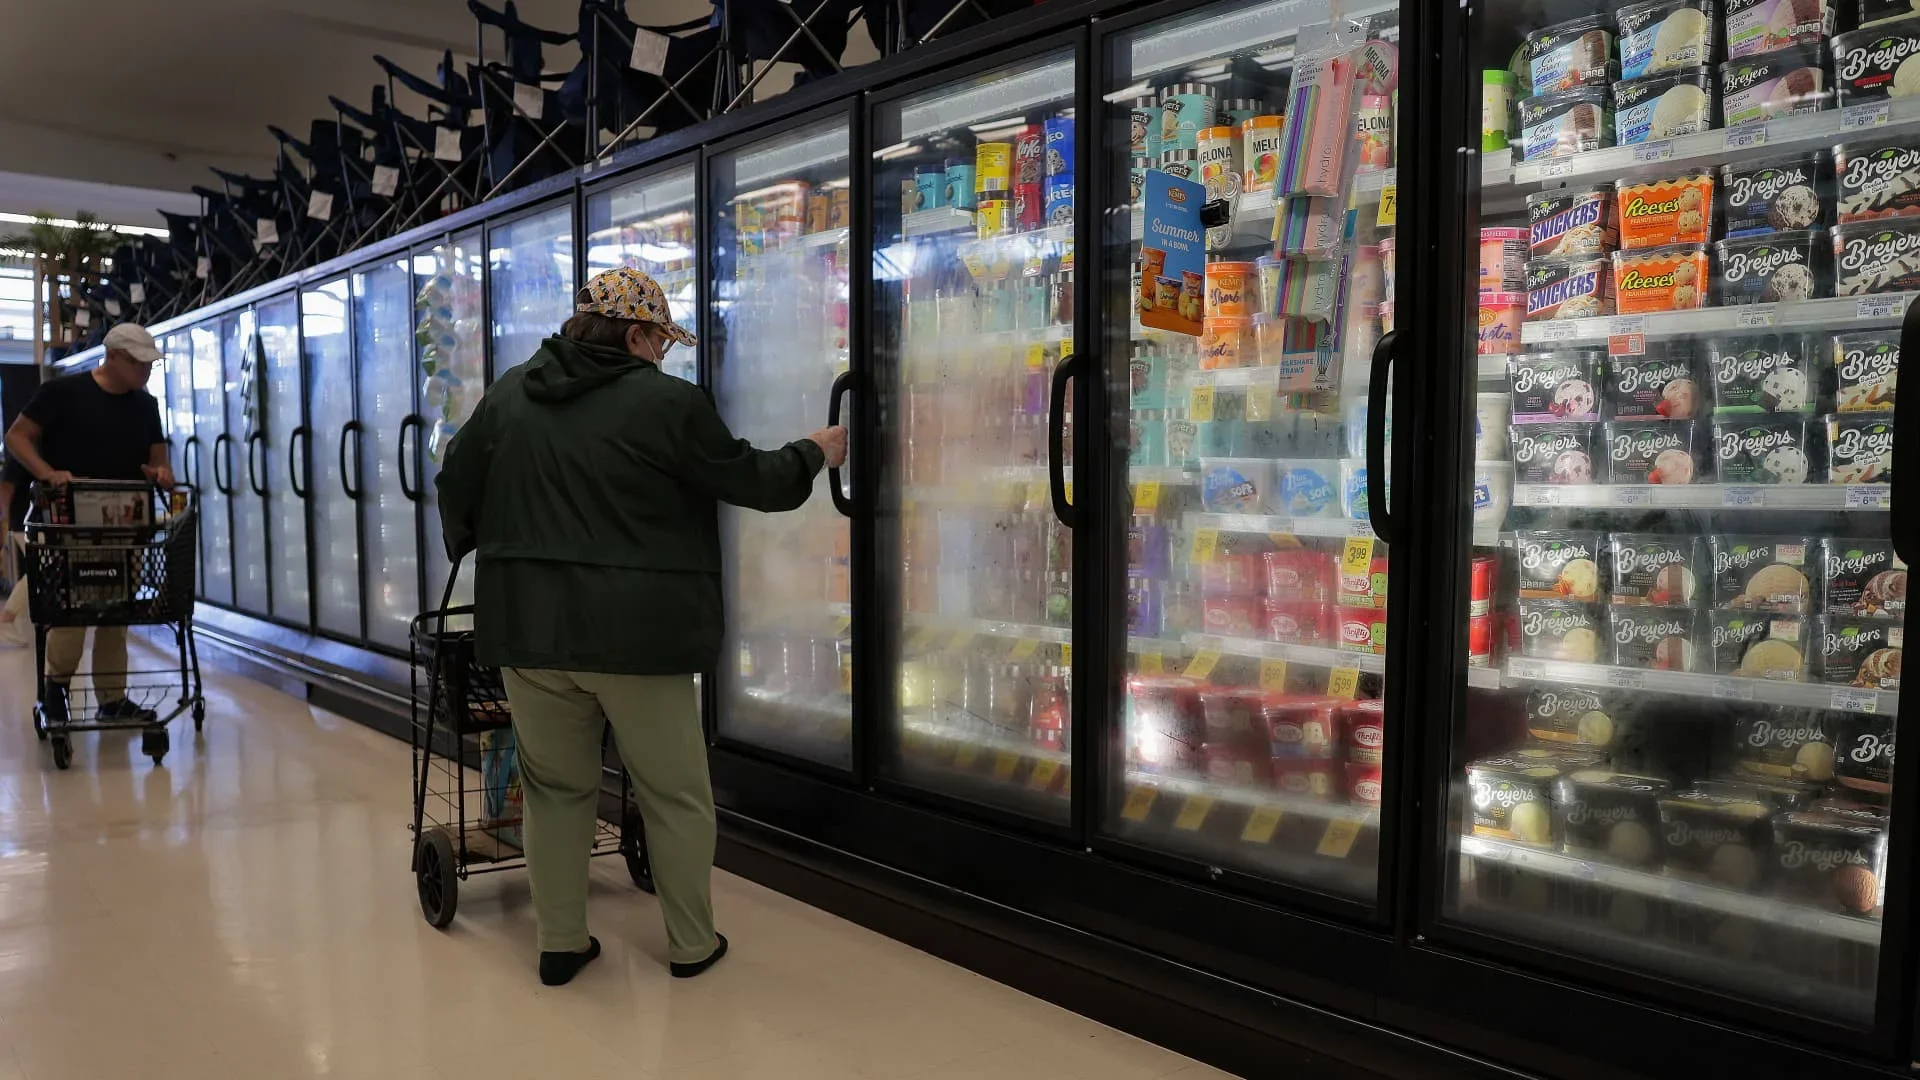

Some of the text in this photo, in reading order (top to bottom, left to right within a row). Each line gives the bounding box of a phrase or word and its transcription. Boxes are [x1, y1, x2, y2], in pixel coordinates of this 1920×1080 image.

[1531, 36, 1560, 57] Breyers
[1841, 37, 1920, 80] Breyer
[1364, 46, 1390, 80] MELONA
[1723, 65, 1769, 94] Breyers
[1616, 87, 1648, 109] Breyers
[1357, 116, 1391, 131] ELONA
[1047, 131, 1065, 144] EO
[1843, 149, 1920, 188] Breyer
[1729, 168, 1808, 207] Breyers
[1531, 201, 1560, 223] Breyers
[1624, 196, 1680, 218] Reese's
[1151, 217, 1201, 243] Summer
[1532, 200, 1600, 246] SNICKERS
[1725, 247, 1804, 282] Breyers
[1841, 233, 1920, 270] Breyer
[1527, 269, 1556, 291] Breyers
[1528, 272, 1597, 313] SNICKERS
[1619, 269, 1675, 291] Reese's
[1717, 351, 1795, 384] Breyers
[1841, 349, 1900, 380] Breye
[1515, 364, 1584, 393] Breyers
[1618, 363, 1690, 394] Breyers
[1516, 434, 1582, 463] Breyers
[1612, 432, 1683, 461] Breyers
[1719, 430, 1796, 460] Breyers
[1836, 429, 1893, 459] Brey
[1348, 547, 1367, 563] 399
[1522, 544, 1590, 569] Breyers
[1618, 548, 1686, 574] Breyers
[1716, 546, 1769, 574] Breyers
[1827, 551, 1886, 579] Breyers
[1343, 577, 1368, 590] Thrifty
[1343, 627, 1368, 639] Thrifty
[1524, 611, 1591, 636] Breyers
[1615, 618, 1685, 644] Breyers
[1712, 621, 1764, 648] Breyers
[1822, 629, 1881, 656] Breyers
[1333, 677, 1352, 694] 599
[1537, 692, 1603, 717] Breyers
[1358, 731, 1383, 744] Thrift
[1748, 720, 1826, 747] Breyers
[1474, 781, 1537, 808] Breyers
[1567, 802, 1638, 825] Breyers
[1666, 821, 1745, 847] Breyers
[1780, 840, 1868, 871] Breyers
